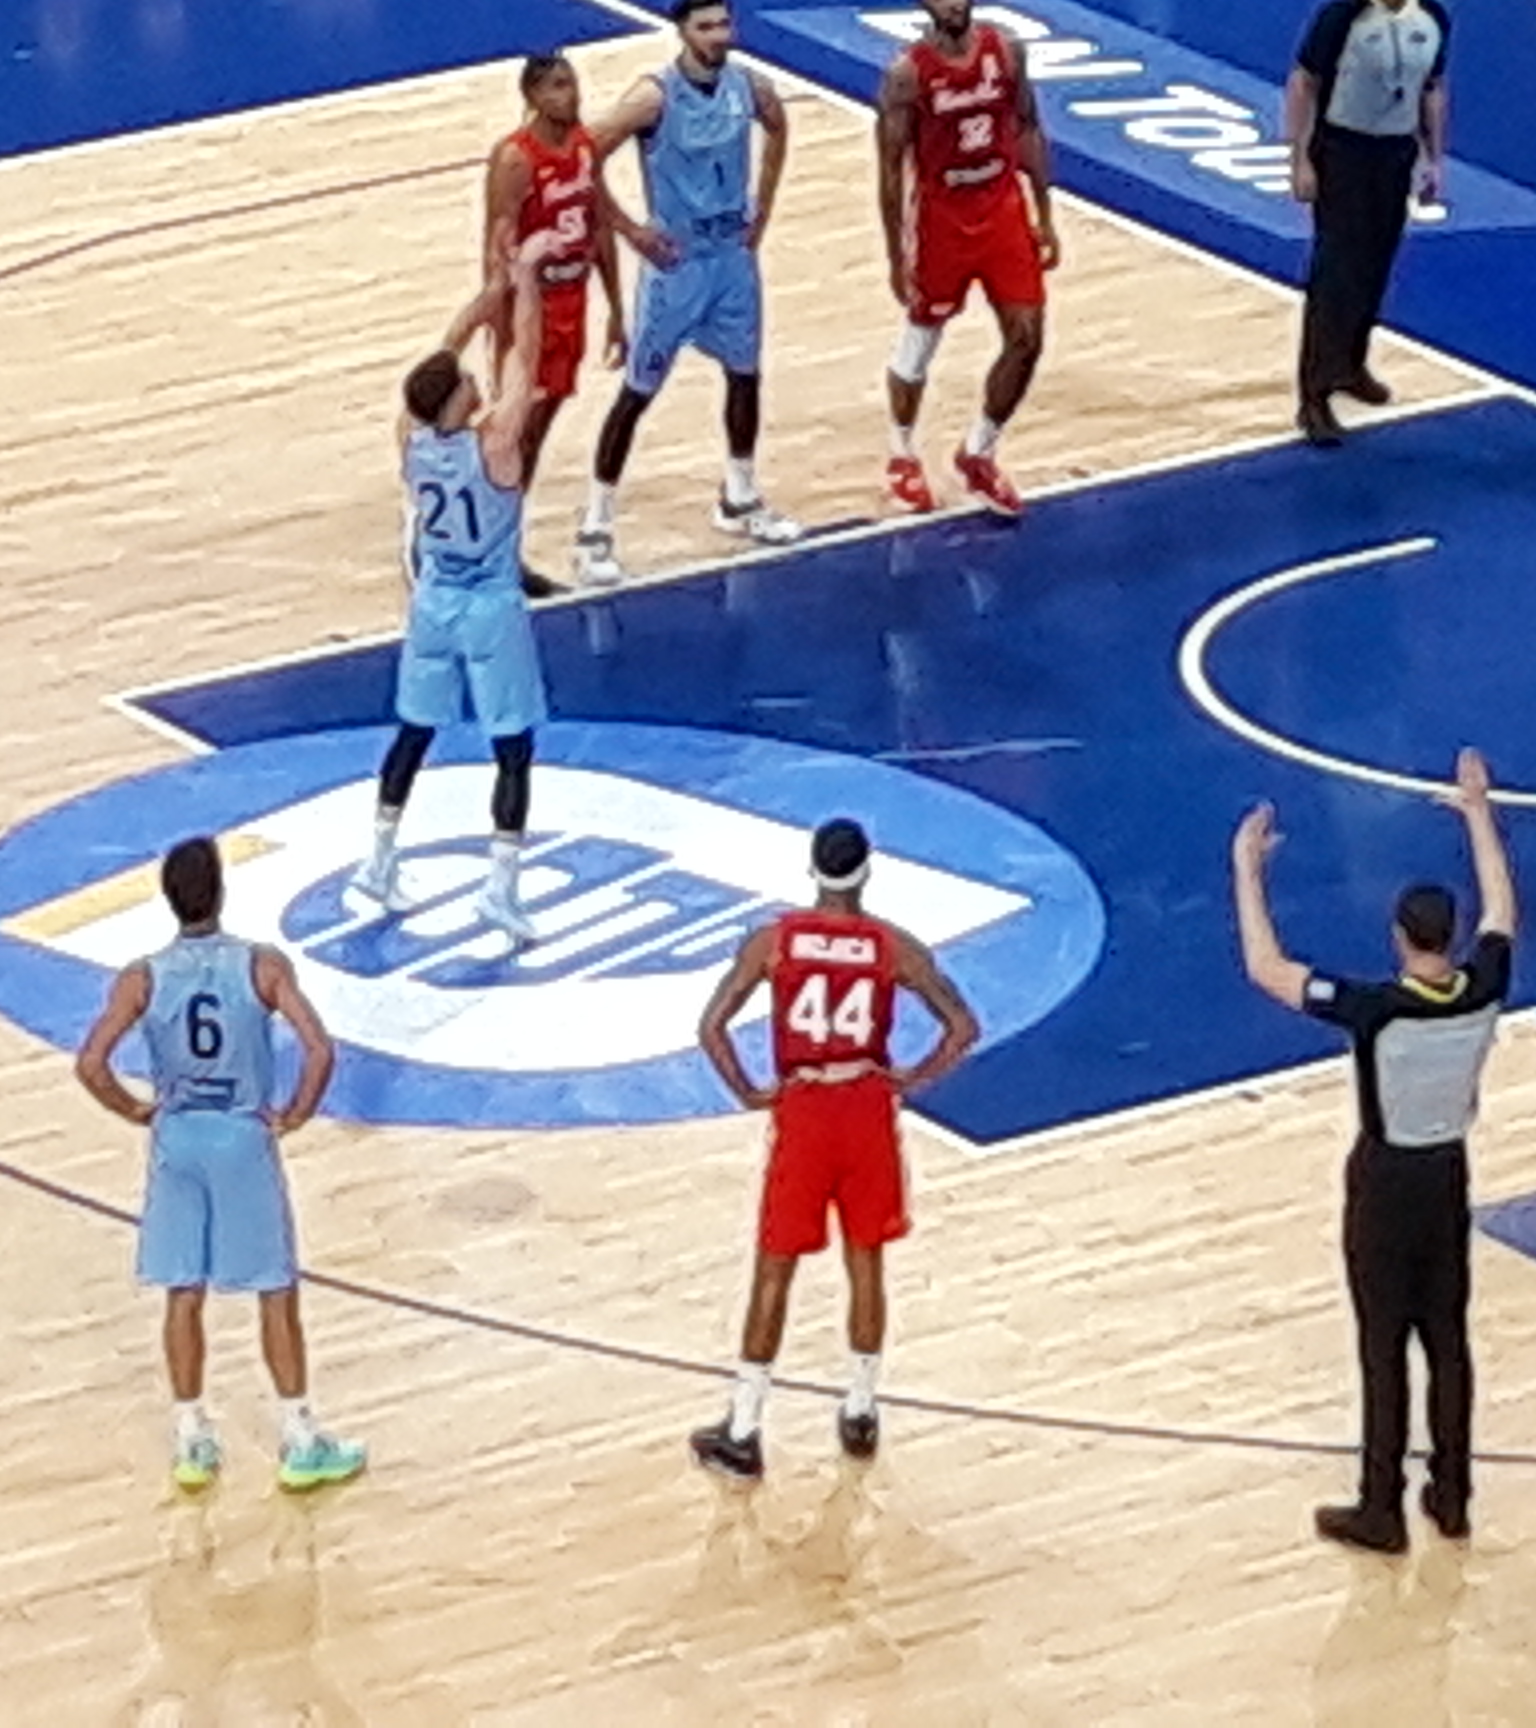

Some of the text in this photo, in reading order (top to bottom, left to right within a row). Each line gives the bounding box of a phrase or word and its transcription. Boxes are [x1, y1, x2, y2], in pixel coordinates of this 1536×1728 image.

[418, 481, 480, 544] 21
[187, 992, 223, 1060] 6
[788, 973, 875, 1047] 44
